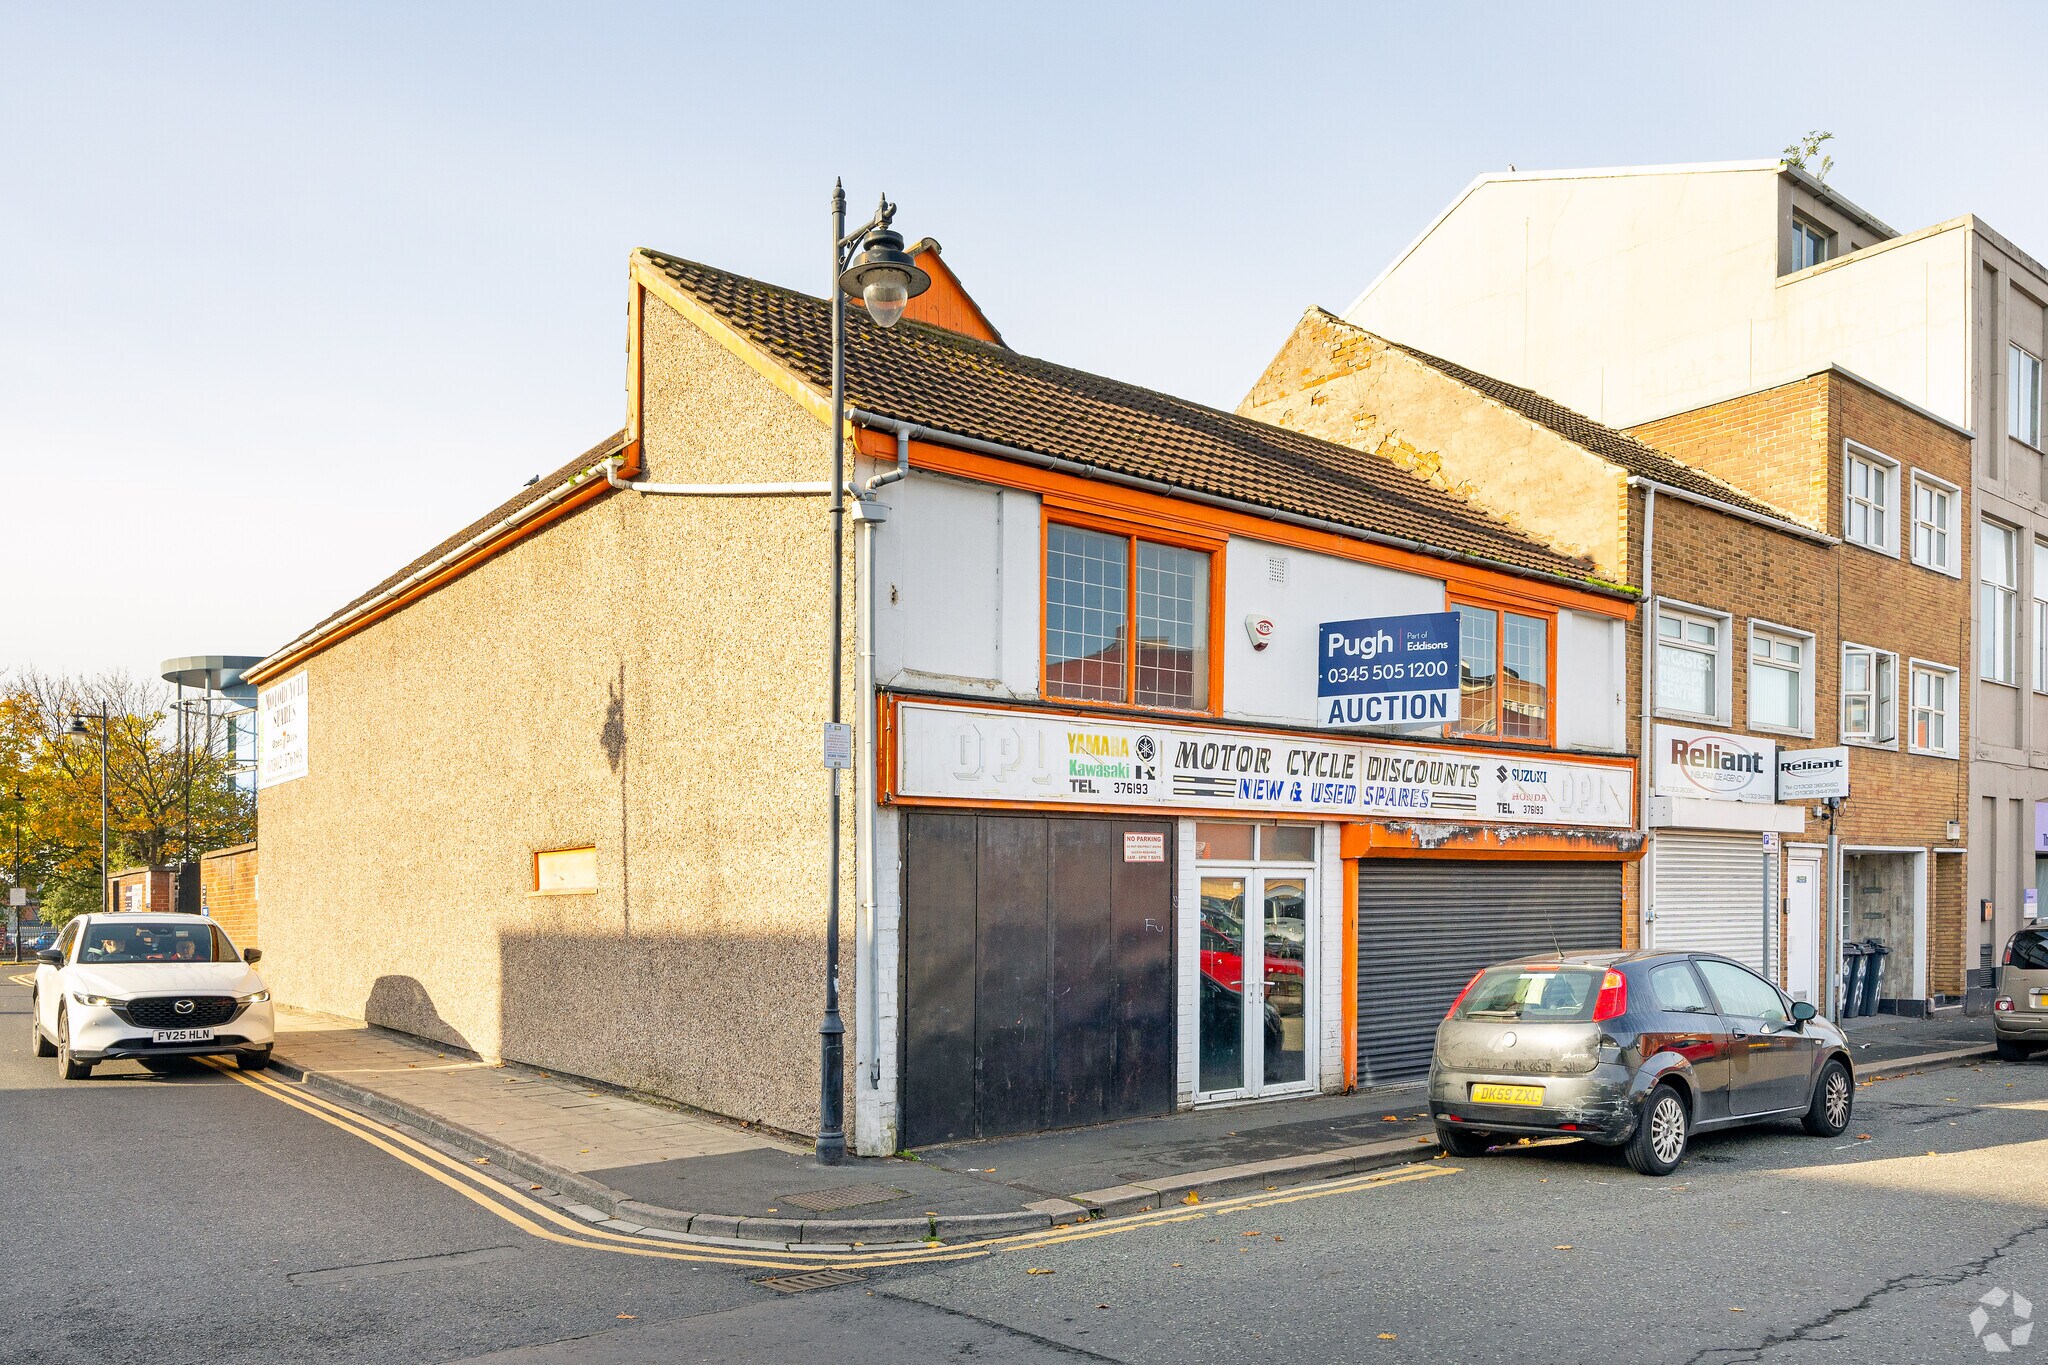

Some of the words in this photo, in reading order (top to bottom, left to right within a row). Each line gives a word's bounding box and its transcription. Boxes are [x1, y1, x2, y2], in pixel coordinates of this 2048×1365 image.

[1407, 632, 1420, 640] Part
[1421, 631, 1428, 639] of
[1328, 629, 1393, 660] Pugh
[1407, 641, 1448, 651] Eddisons
[1328, 666, 1369, 683] 0345
[1372, 663, 1405, 680] 505
[1408, 661, 1448, 678] 1200
[1328, 693, 1447, 724] AUCTION
[1067, 733, 1129, 757] YAMAHA
[1671, 739, 1763, 774] Reliant
[1070, 759, 1129, 779] Kawasaki
[1174, 741, 1272, 774] MOTOR
[1286, 749, 1355, 779] CYCLE
[1367, 756, 1480, 788] DISCOUNTS
[1781, 759, 1843, 771] Reliant
[1511, 768, 1547, 783] SUZUKI
[1691, 770, 1723, 781] INSURANCE
[1723, 773, 1745, 783] AGENCY
[1069, 779, 1100, 793] TEL.
[1113, 782, 1149, 795] 376193
[1238, 778, 1284, 800] NEW
[1290, 781, 1302, 802] &
[1311, 782, 1356, 805] USED
[1364, 786, 1429, 808] SPARES
[1512, 793, 1547, 802] HONDA
[1497, 802, 1515, 814] TEL.
[1523, 805, 1544, 815] 376193
[158, 1031, 186, 1040] FV25
[189, 1030, 209, 1039] HLN
[1481, 1087, 1512, 1101] DK59
[1515, 1089, 1538, 1102] ZXL
